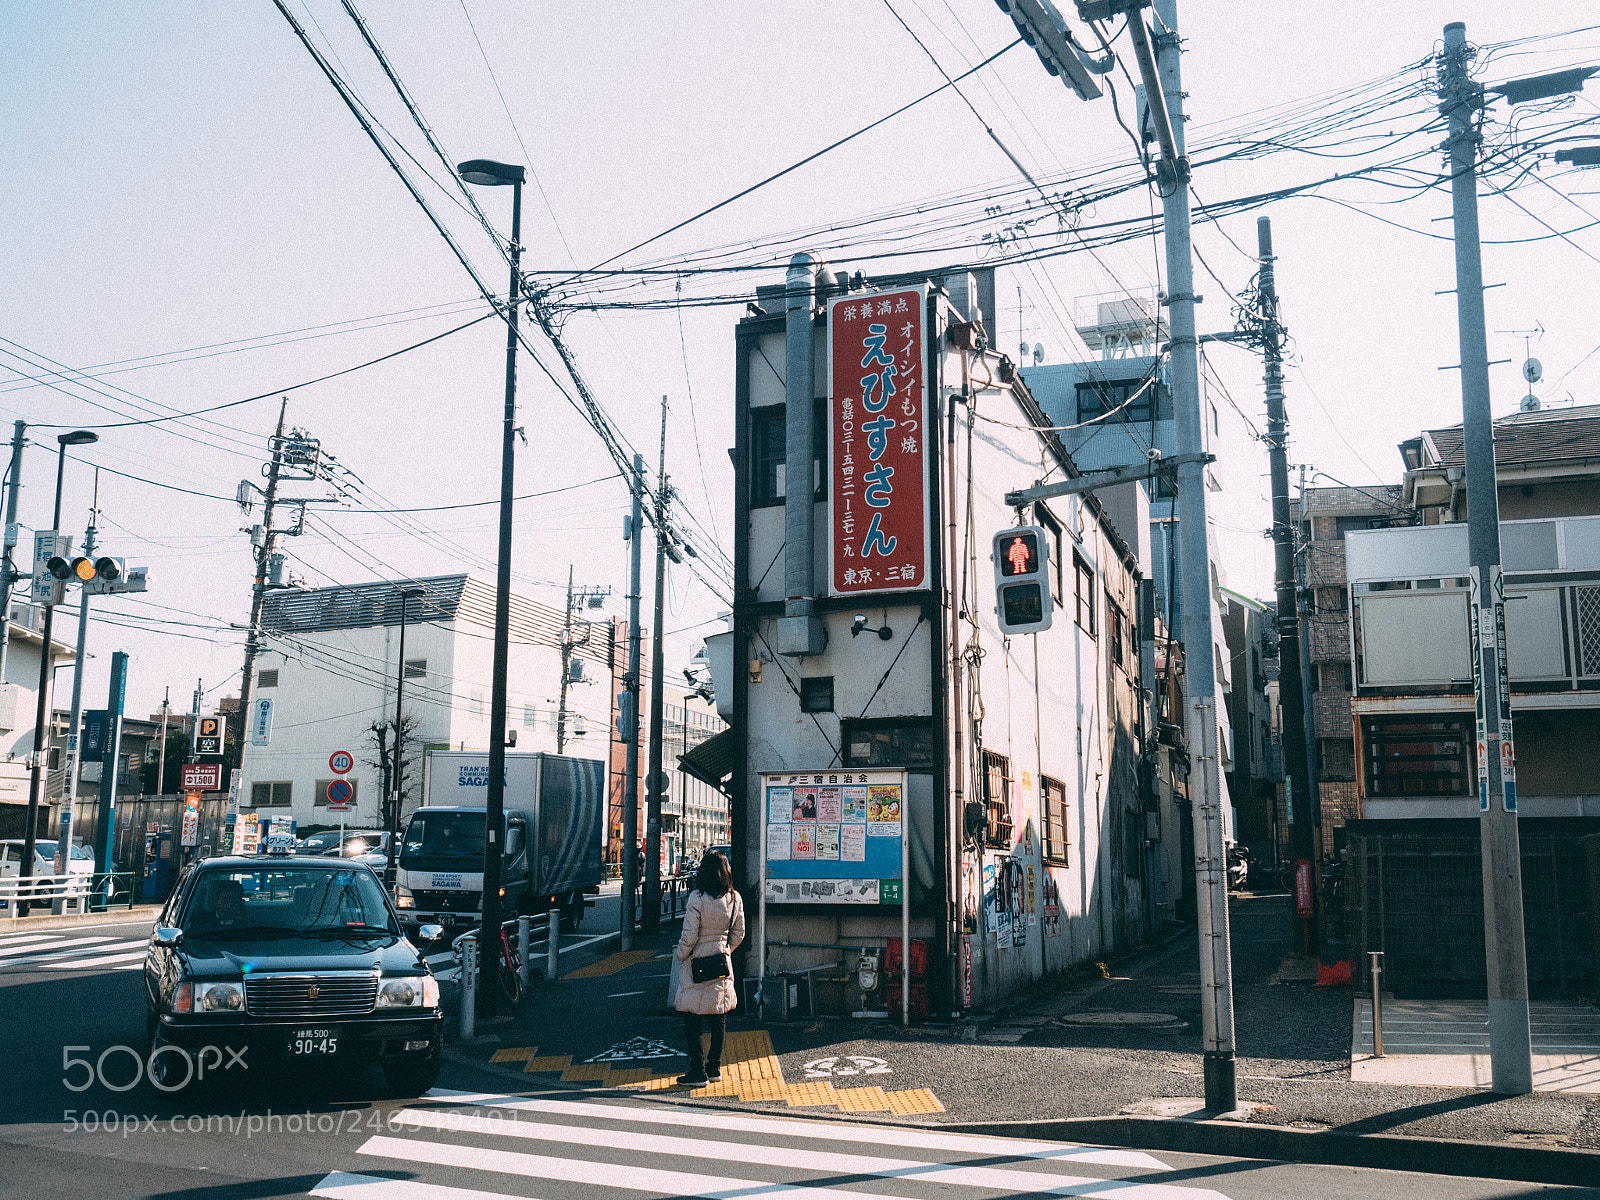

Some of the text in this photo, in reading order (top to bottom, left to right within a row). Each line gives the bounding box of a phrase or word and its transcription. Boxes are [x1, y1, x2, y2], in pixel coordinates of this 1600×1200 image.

[843, 297, 909, 321] 栄養満点
[899, 321, 918, 454] オイシイもつ焼
[860, 322, 898, 559] えびすさん
[842, 563, 917, 586] 東京・三宿
[202, 738, 215, 752] 空
[334, 757, 349, 768] 40
[799, 773, 868, 785] 三宿自治会
[269, 836, 291, 844] グリーン
[431, 880, 462, 888] SAGAWA
[314, 1029, 329, 1038] 500
[295, 1038, 338, 1055] 90-45
